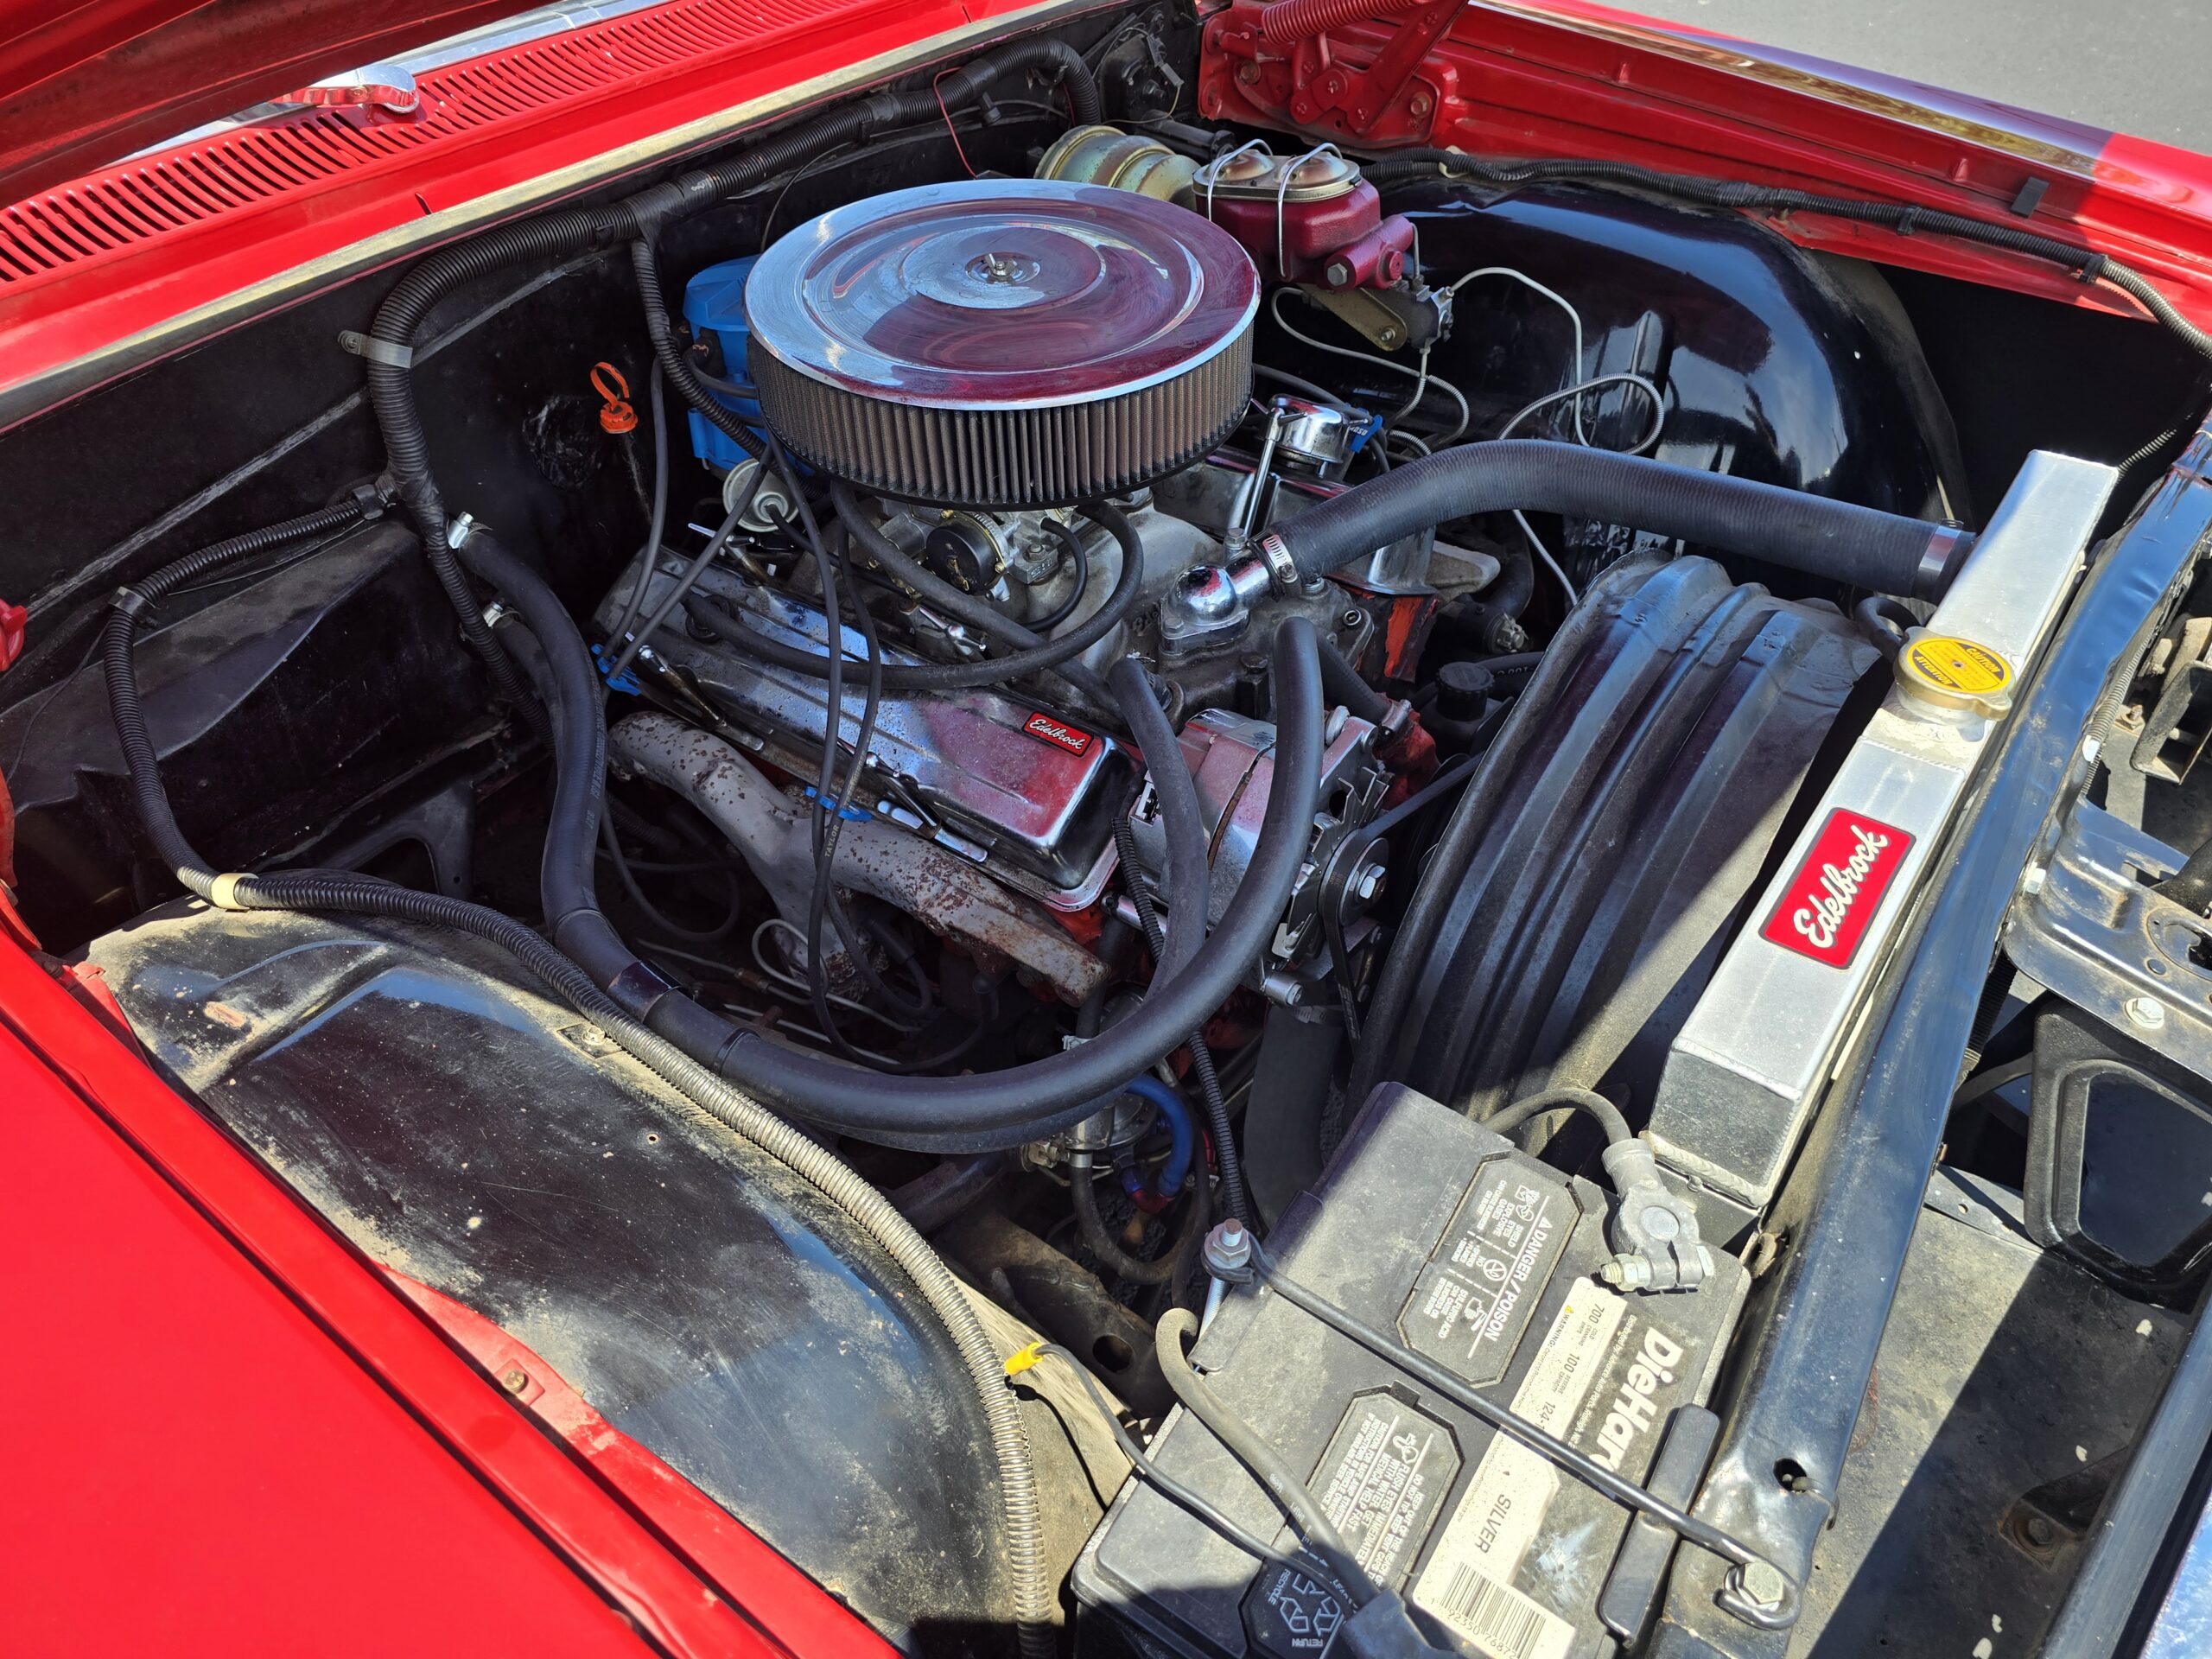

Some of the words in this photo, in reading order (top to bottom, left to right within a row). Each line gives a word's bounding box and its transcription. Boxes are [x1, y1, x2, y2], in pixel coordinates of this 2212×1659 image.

[1914, 655, 1953, 684] ATTENTION
[1967, 648, 2001, 673] CAUTION
[1029, 719, 1085, 749] Edelbrock
[824, 824, 840, 857] TAYLOR
[1793, 824, 1888, 948] Edelbrock
[1491, 1198, 1507, 1219] GASES
[1492, 1202, 1514, 1236] EXPLOSIVE
[1502, 1220, 1516, 1237] EYES
[1507, 1224, 1523, 1247] SHIELD
[1475, 1255, 1485, 1267] NO
[1513, 1230, 1547, 1281] DANGER
[1450, 1285, 1459, 1297] CAN
[1446, 1289, 1467, 1322] SULFURIC
[1484, 1290, 1517, 1340] POISON
[1588, 1303, 1605, 1323] 700
[1438, 1320, 1451, 1338] ACID
[1548, 1313, 1569, 1347] WARNING:
[1576, 1321, 1586, 1333] AMPS
[1578, 1325, 1592, 1346] CRANKING
[1588, 1327, 1598, 1339] COLD
[1618, 1314, 1637, 1346] Distributed
[1563, 1353, 1580, 1372] 100
[1601, 1353, 1618, 1377] Advance
[1551, 1371, 1564, 1392] CAPACITY
[1557, 1374, 1570, 1394] RESERVE
[1594, 1376, 1605, 1391] Auto
[1360, 1419, 1371, 1433] NOT
[1534, 1402, 1555, 1429] 124-1
[1343, 1432, 1363, 1464] AVAILABLE
[1355, 1417, 1381, 1459] INSTRUCTIONS
[1363, 1448, 1374, 1462] FOR
[1335, 1462, 1348, 1479] SEEK
[1354, 1462, 1368, 1479] SAFE
[1368, 1452, 1390, 1485] MEDICAL
[1384, 1459, 1400, 1479] WITH
[1390, 1464, 1408, 1491] FLUSH
[1413, 1473, 1422, 1485] DO
[1338, 1468, 1355, 1493] VEHICLE
[1346, 1478, 1358, 1496] JUMP
[1321, 1478, 1339, 1507] SERVICE
[1358, 1486, 1374, 1509] HELP
[1369, 1480, 1389, 1507] WATER.
[1380, 1490, 1396, 1512] EYES
[1406, 1484, 1417, 1500] NOT
[1412, 1491, 1423, 1510] KEEP
[1346, 1508, 1363, 1531] FAST
[1360, 1510, 1374, 1528] GET
[1390, 1514, 1402, 1533] KEEP
[1403, 1510, 1414, 1524] OUT
[1475, 1494, 1510, 1553] SILVER
[1397, 1524, 1408, 1536] OF
[1381, 1533, 1394, 1551] VENT
[1389, 1536, 1402, 1551] THE
[1371, 1551, 1384, 1571] CAPS
[1378, 1550, 1395, 1574] REACH
[1268, 1568, 1291, 1605] RECYCLE
[1292, 1638, 1324, 1648] RETURN
[1448, 1608, 1480, 1635] 92350
[1484, 1632, 1516, 1659] 76872
